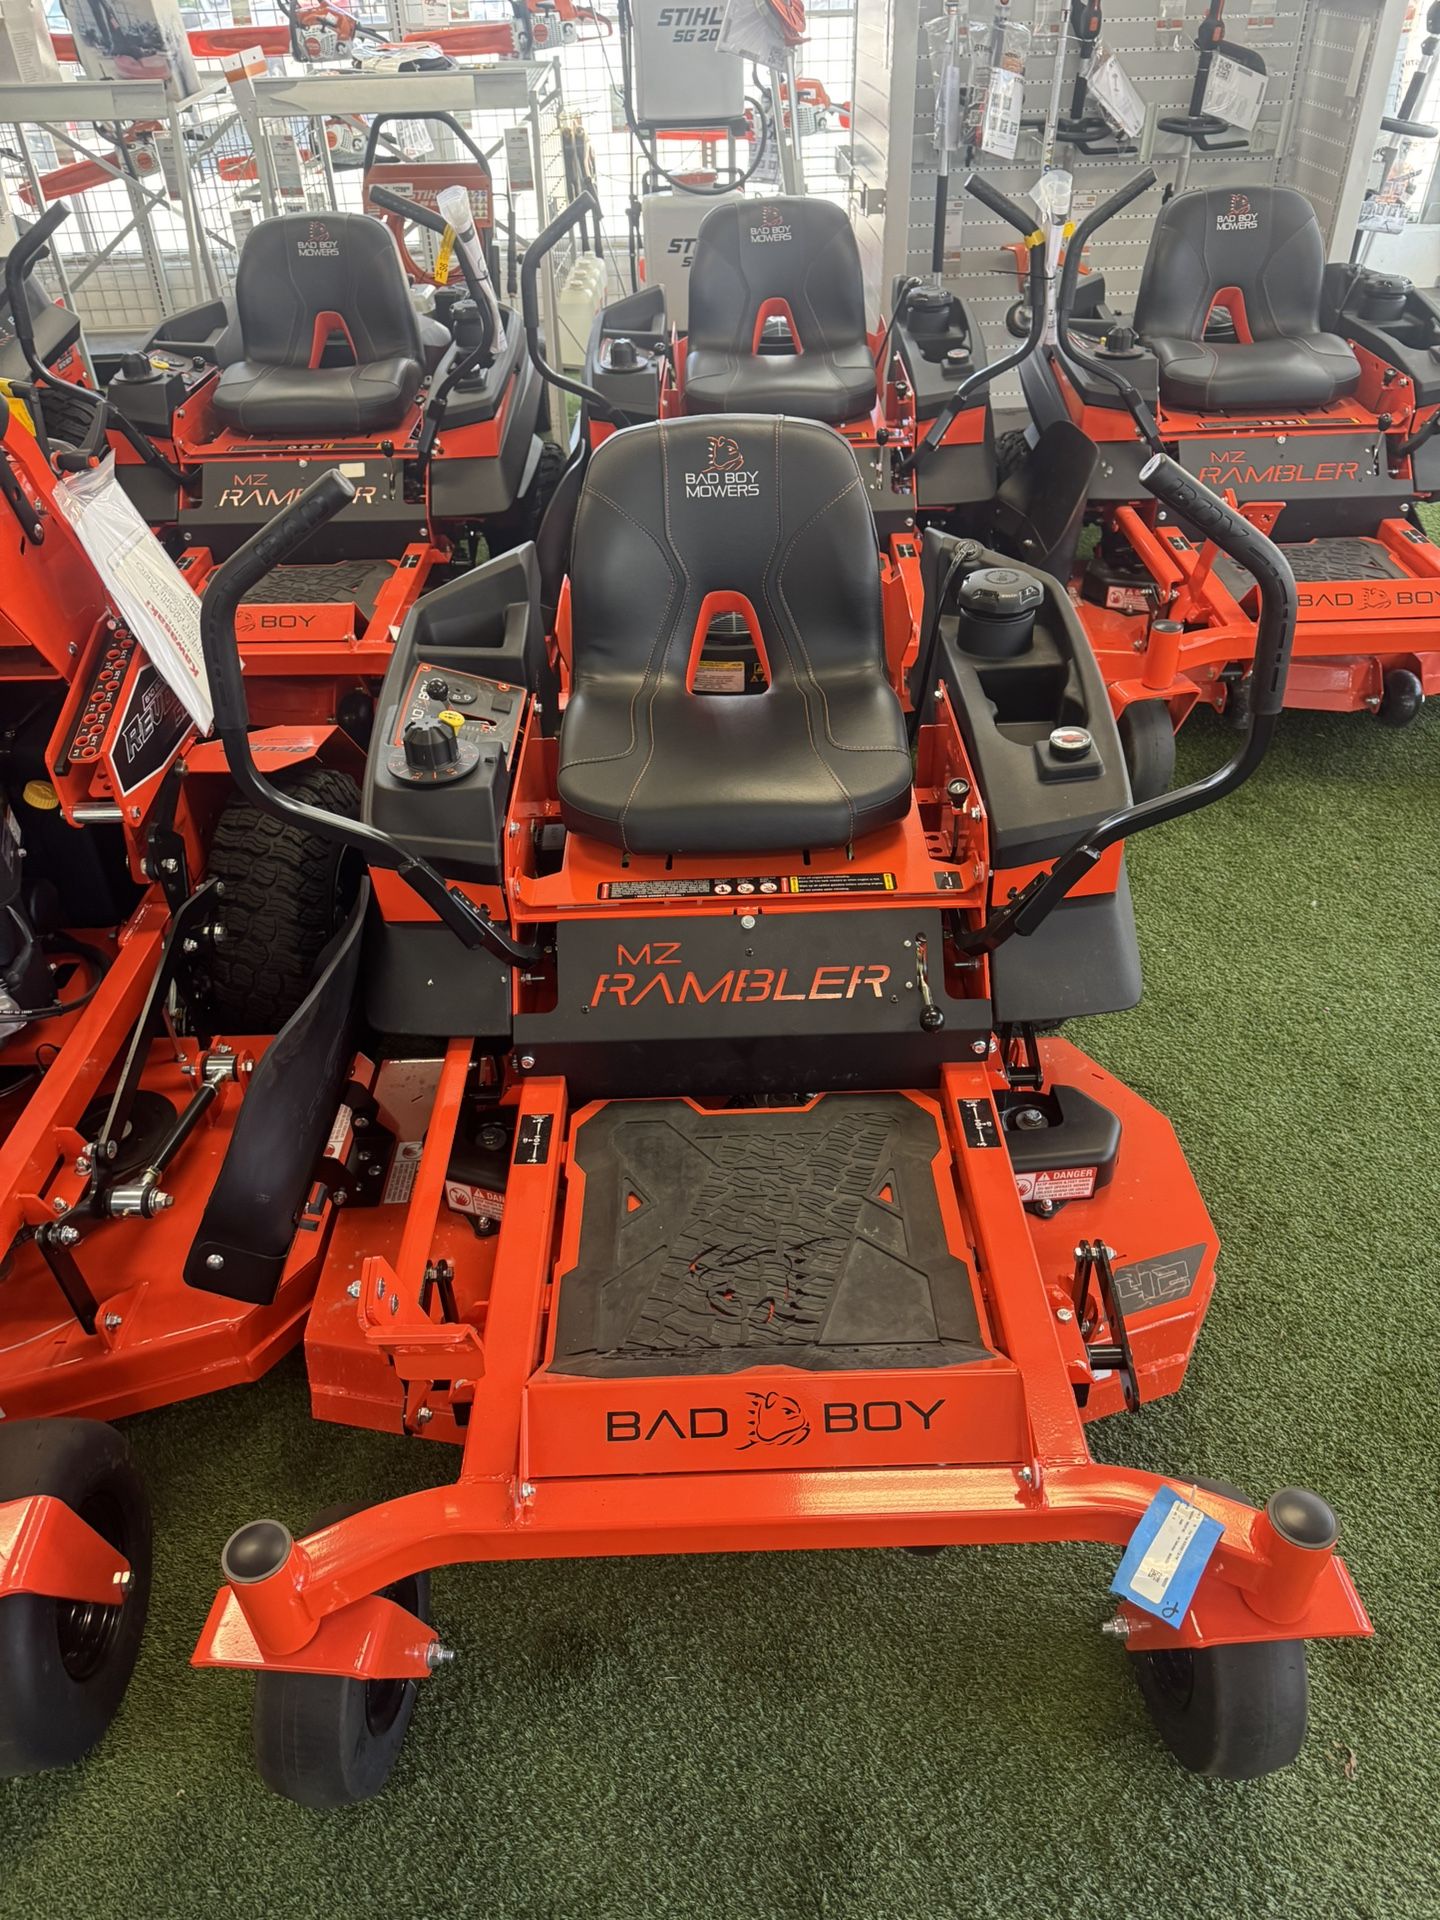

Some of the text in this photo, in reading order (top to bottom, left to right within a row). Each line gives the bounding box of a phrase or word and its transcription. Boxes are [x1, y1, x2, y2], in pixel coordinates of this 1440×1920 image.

[657, 7, 722, 26] STIHL
[673, 30, 696, 42] SG
[698, 30, 719, 42] 20
[1216, 220, 1258, 230] MOWERS
[1217, 213, 1258, 223] BAD BOY
[750, 225, 792, 235] BAD BOY
[751, 233, 792, 242] MOWERS
[297, 241, 338, 249] BAD BOY
[298, 248, 340, 257] MOWERS
[1210, 450, 1247, 464] MZ
[233, 473, 268, 486] MZ
[685, 471, 759, 485] BAD BOY
[1199, 460, 1360, 485] RAMBLER
[686, 484, 760, 499] MOWERS
[1297, 591, 1440, 607] BAD BO
[261, 615, 316, 629] BOY
[144, 599, 200, 678] Kawasaki
[617, 942, 683, 967] MZ
[590, 964, 892, 1008] RAMBLER
[1053, 1169, 1093, 1180] DANGER
[606, 1399, 946, 1442] BAD BOY
